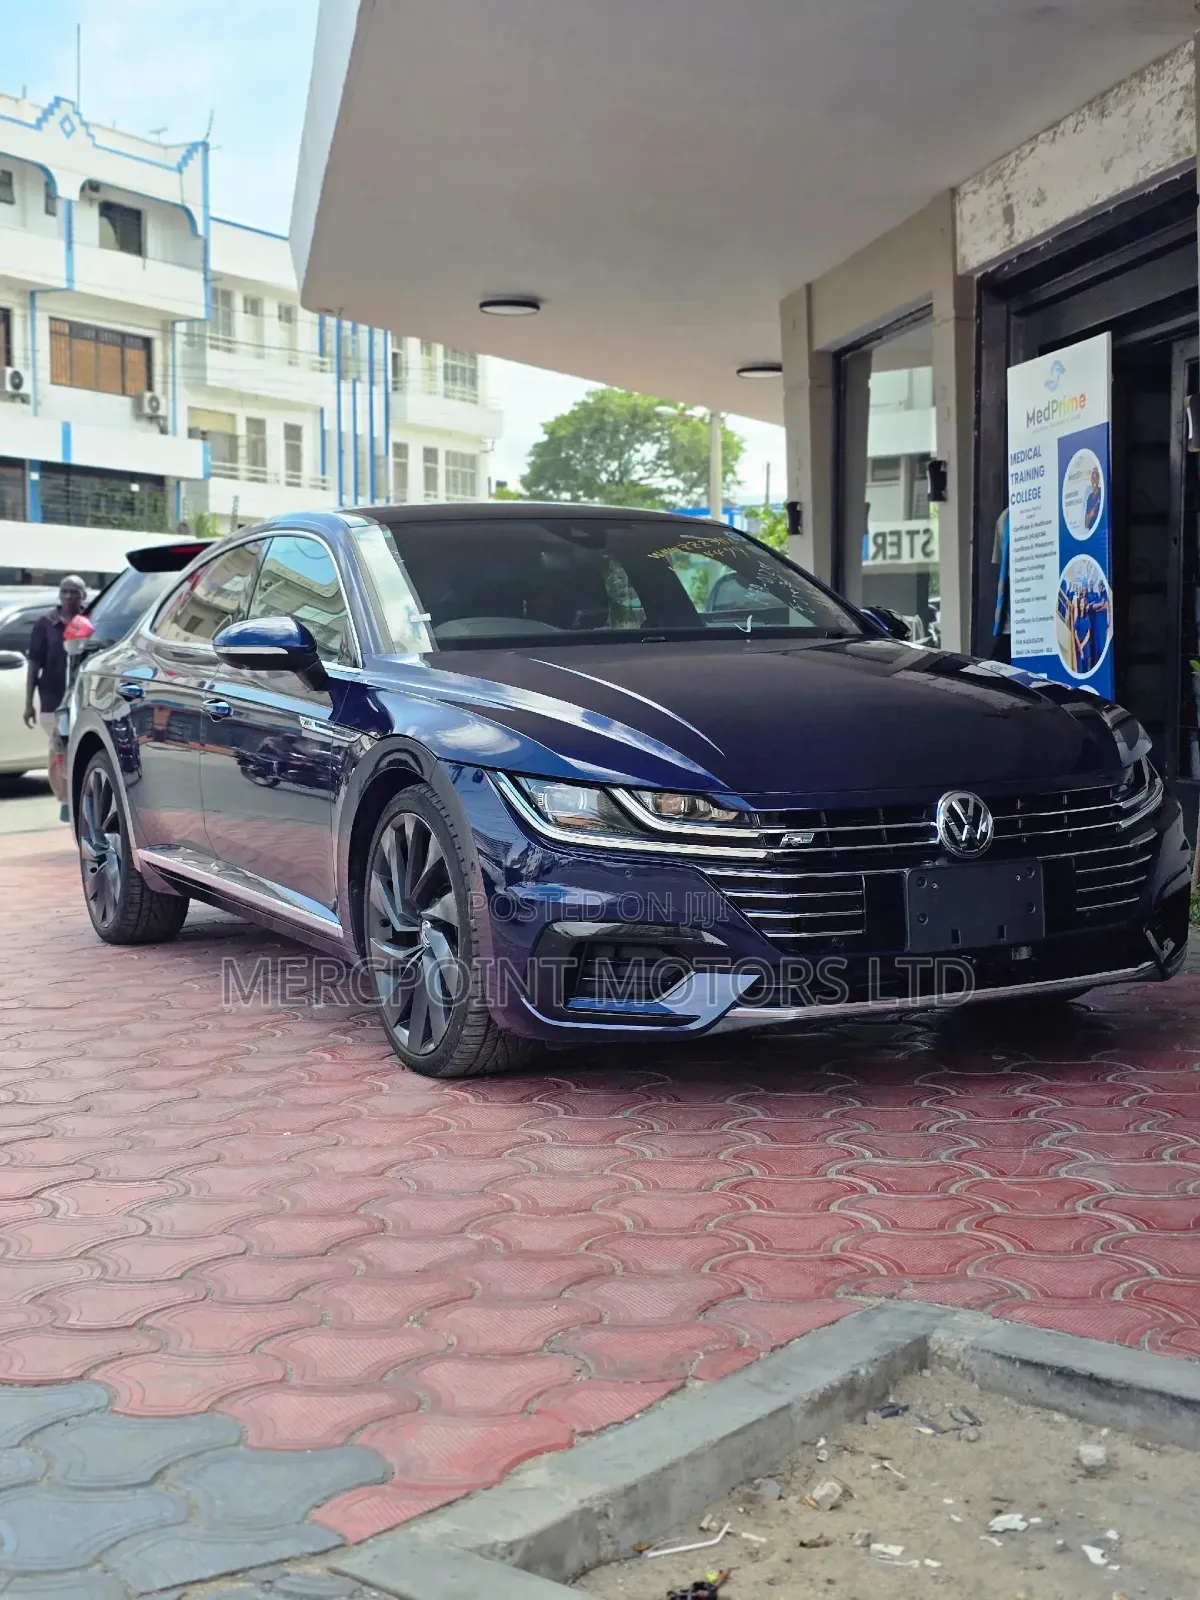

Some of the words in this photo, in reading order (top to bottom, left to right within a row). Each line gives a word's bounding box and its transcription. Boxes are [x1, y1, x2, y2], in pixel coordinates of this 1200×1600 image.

[1026, 393, 1086, 428] MedPrime
[1010, 445, 1042, 467] MEDICAL
[1010, 465, 1045, 486] TRAINING
[1010, 486, 1042, 506] COLLEGE
